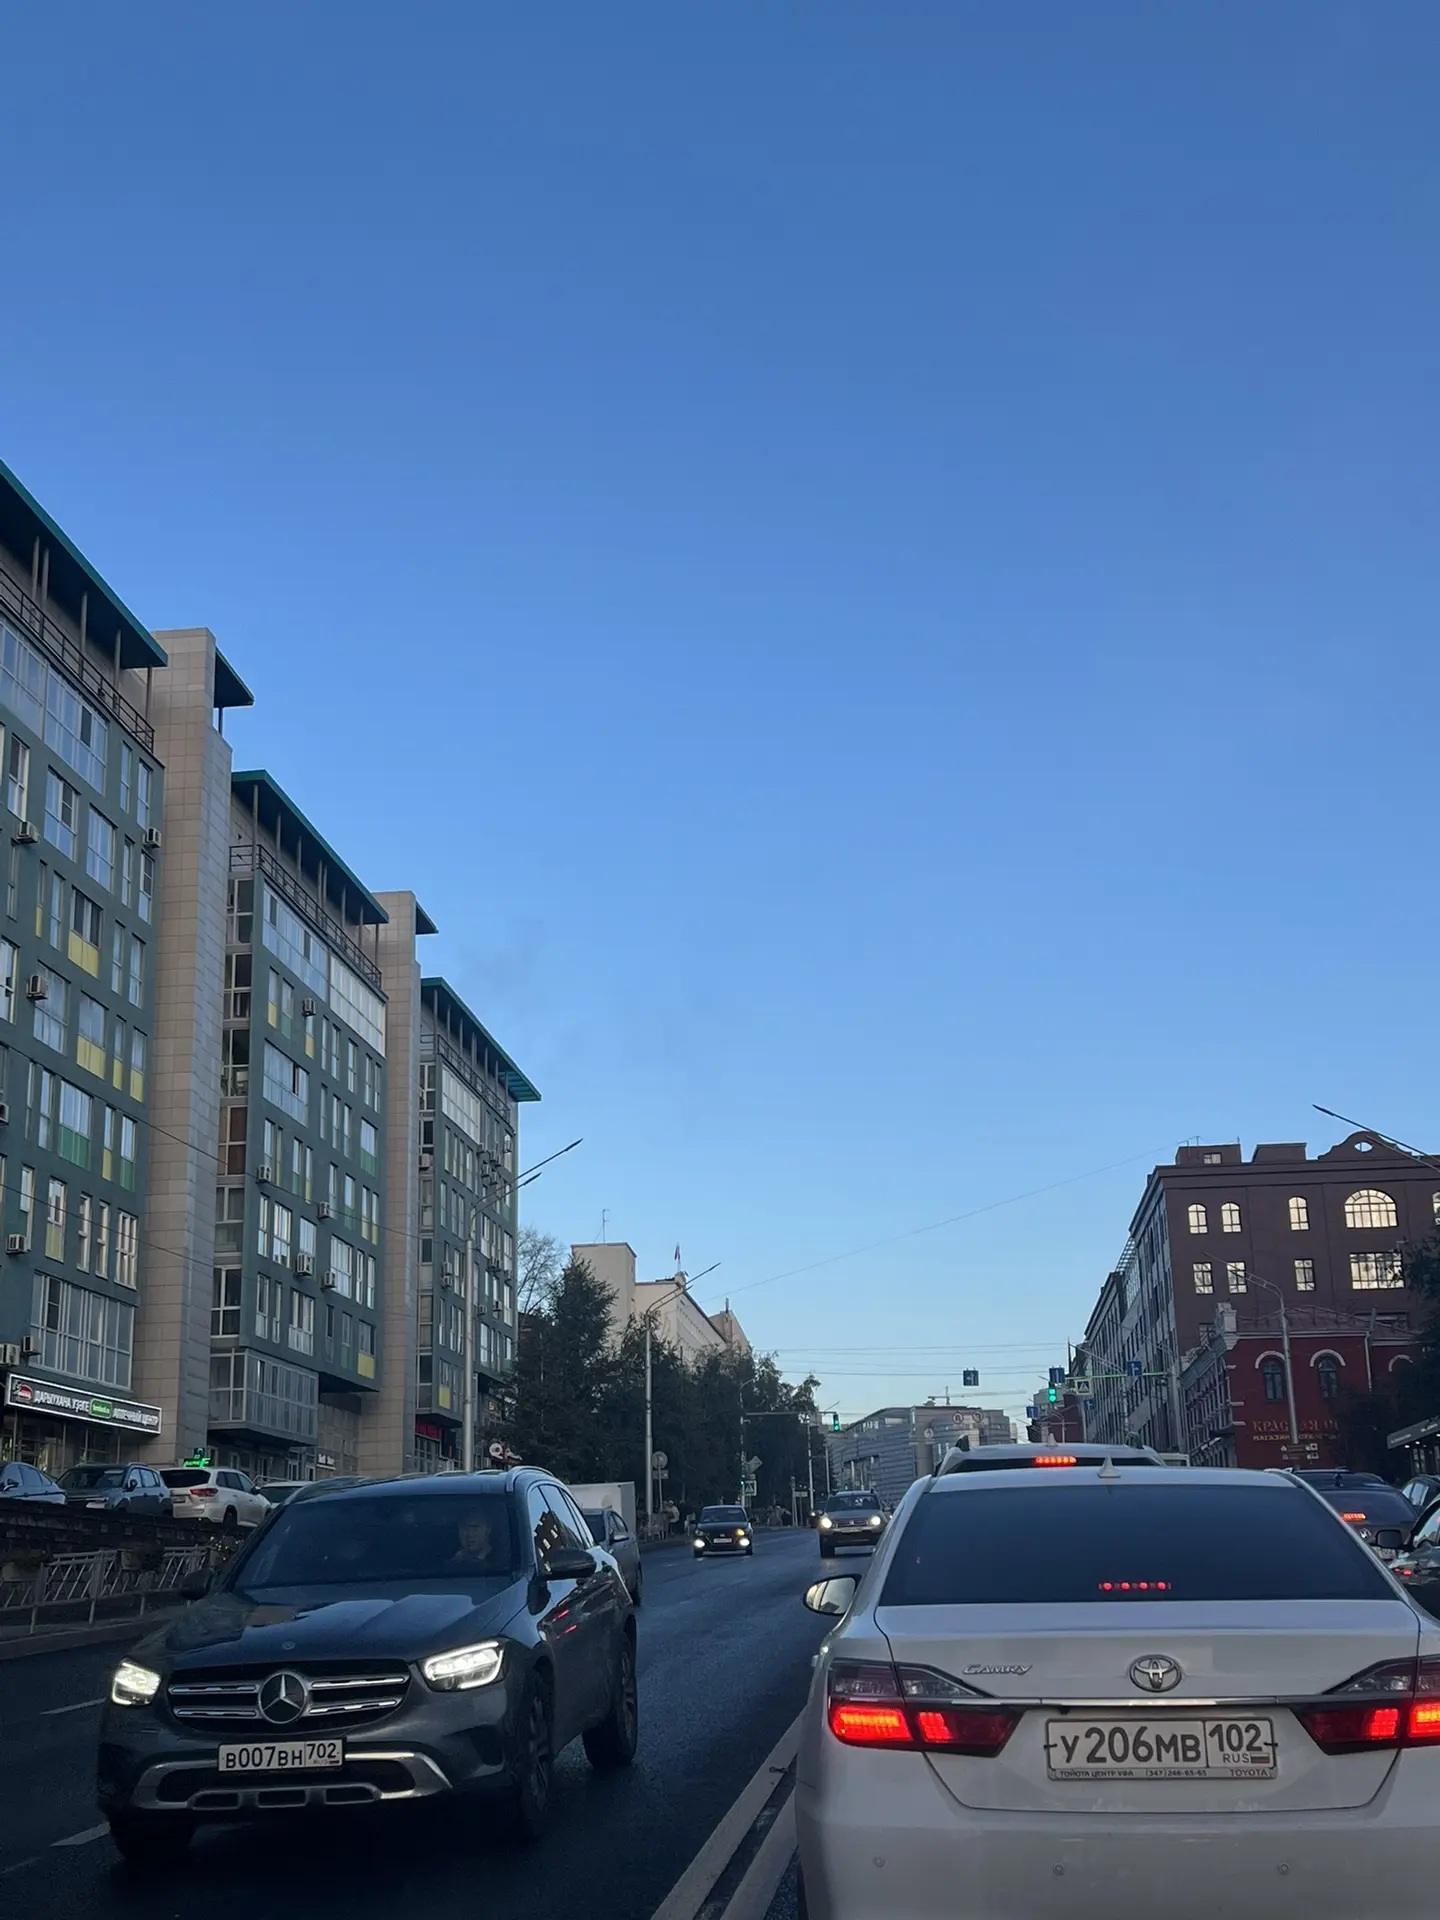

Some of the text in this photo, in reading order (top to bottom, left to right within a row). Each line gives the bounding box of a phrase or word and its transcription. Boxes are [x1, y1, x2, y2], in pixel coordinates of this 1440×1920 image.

[1208, 1723, 1263, 1752] 102
[307, 1742, 336, 1760] 702
[1223, 1753, 1249, 1763] RUS
[1145, 1768, 1167, 1778] (347)
[1229, 1768, 1268, 1777] TOYOTA
